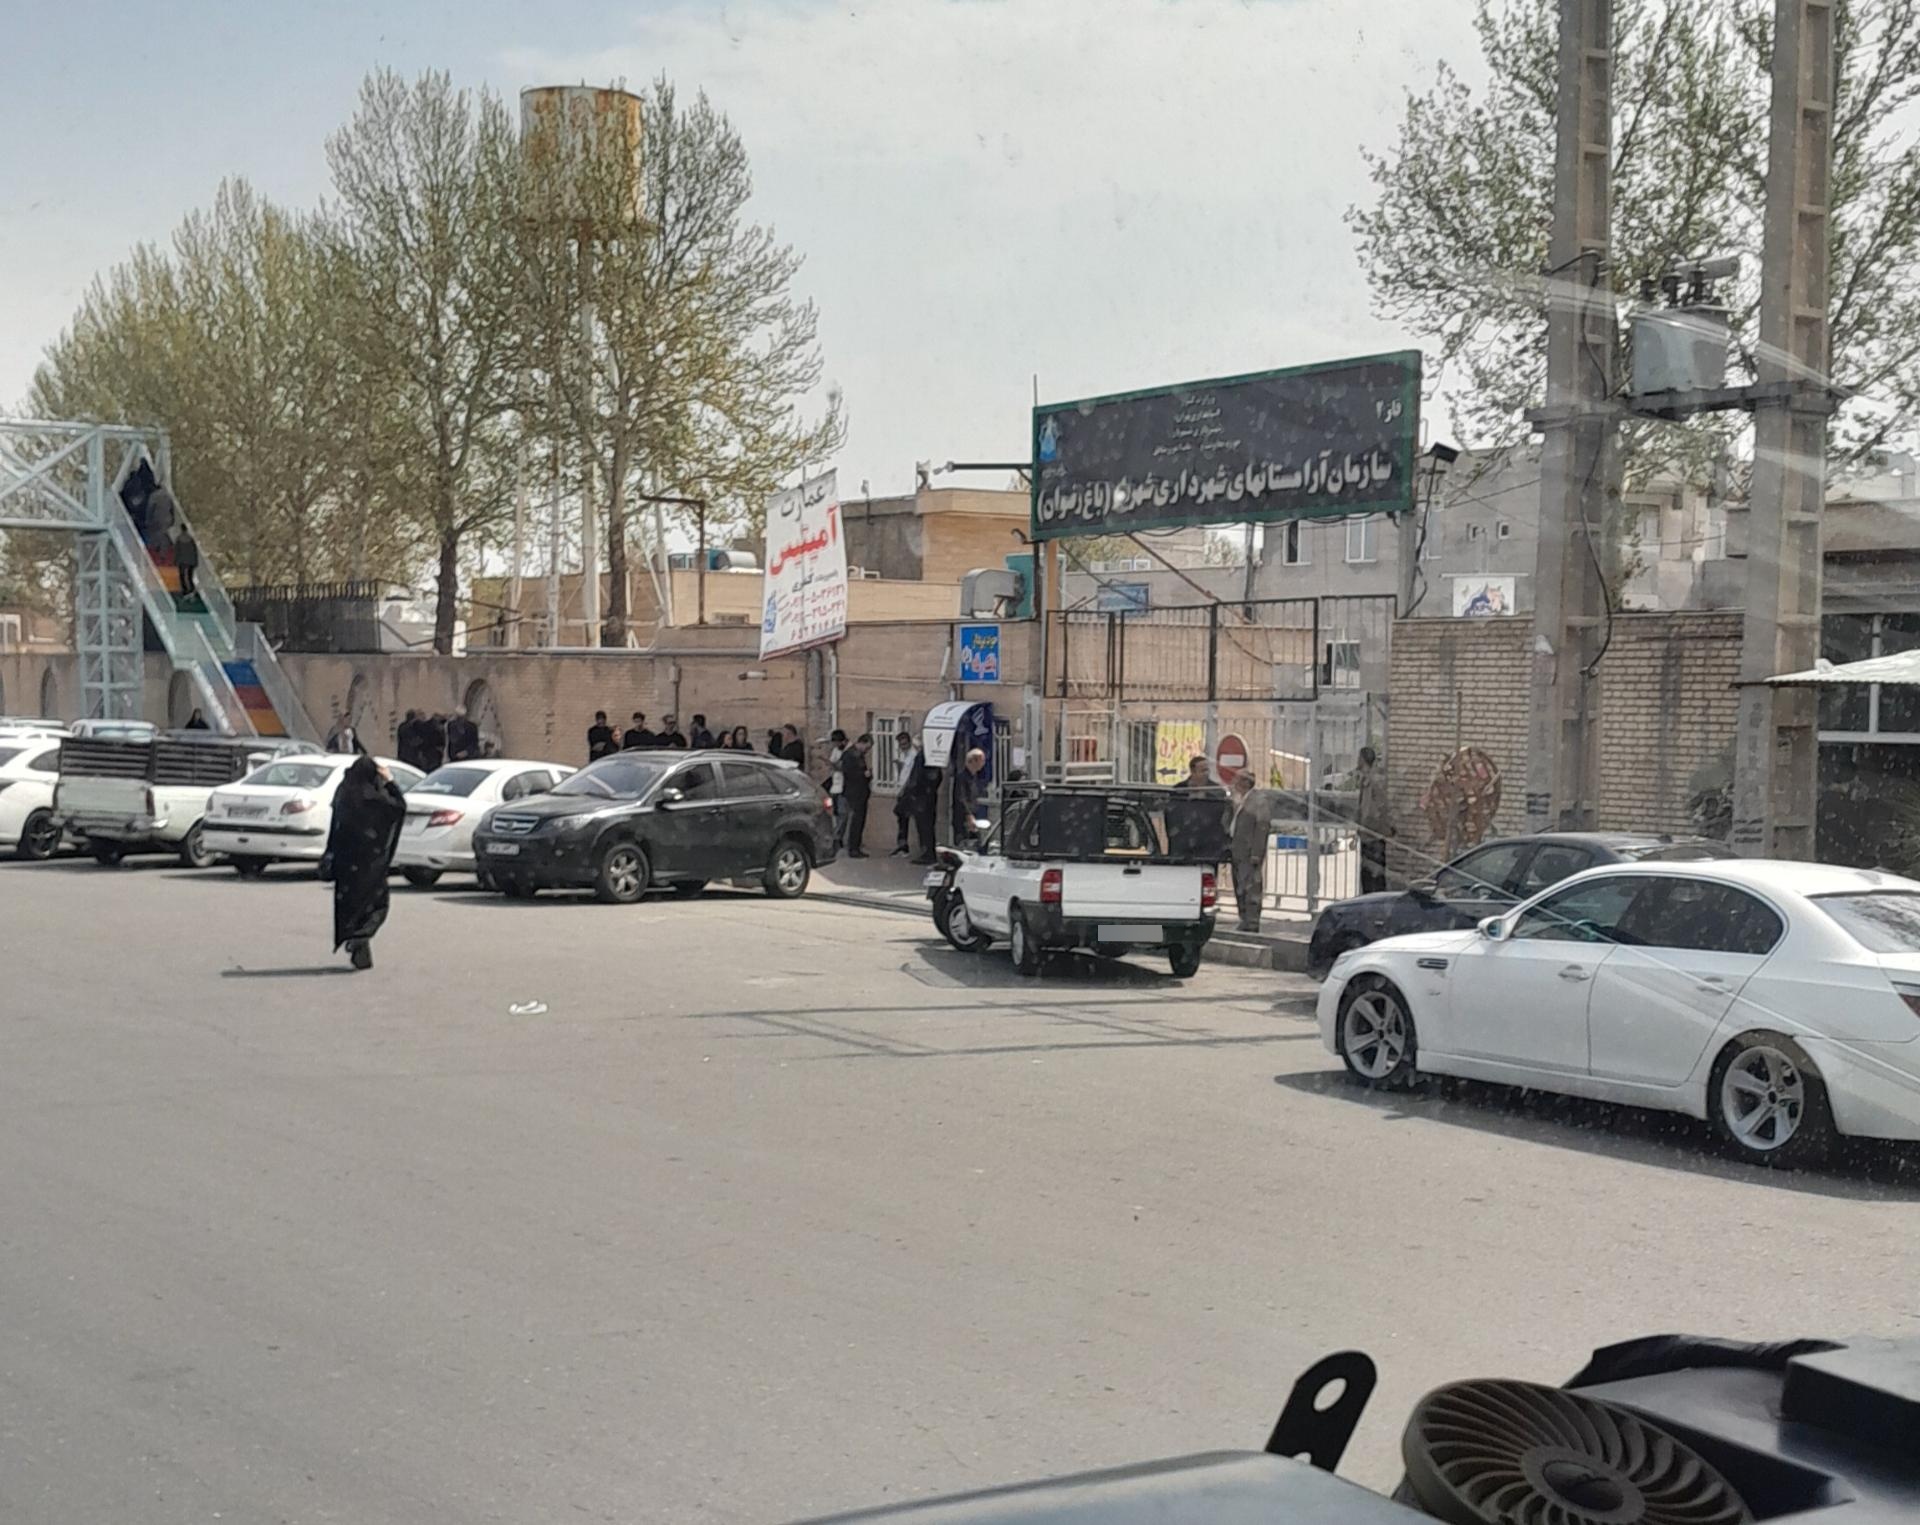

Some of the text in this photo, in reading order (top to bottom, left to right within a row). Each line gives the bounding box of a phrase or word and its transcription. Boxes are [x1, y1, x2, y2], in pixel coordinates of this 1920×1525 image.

[1154, 464, 1228, 507] شهرداری
[1226, 448, 1333, 501] آرامستانهای
[1327, 449, 1392, 495] سازمان
[780, 484, 827, 522] عمارت
[1037, 483, 1083, 524] رضوان)
[1082, 481, 1110, 520] (باغ
